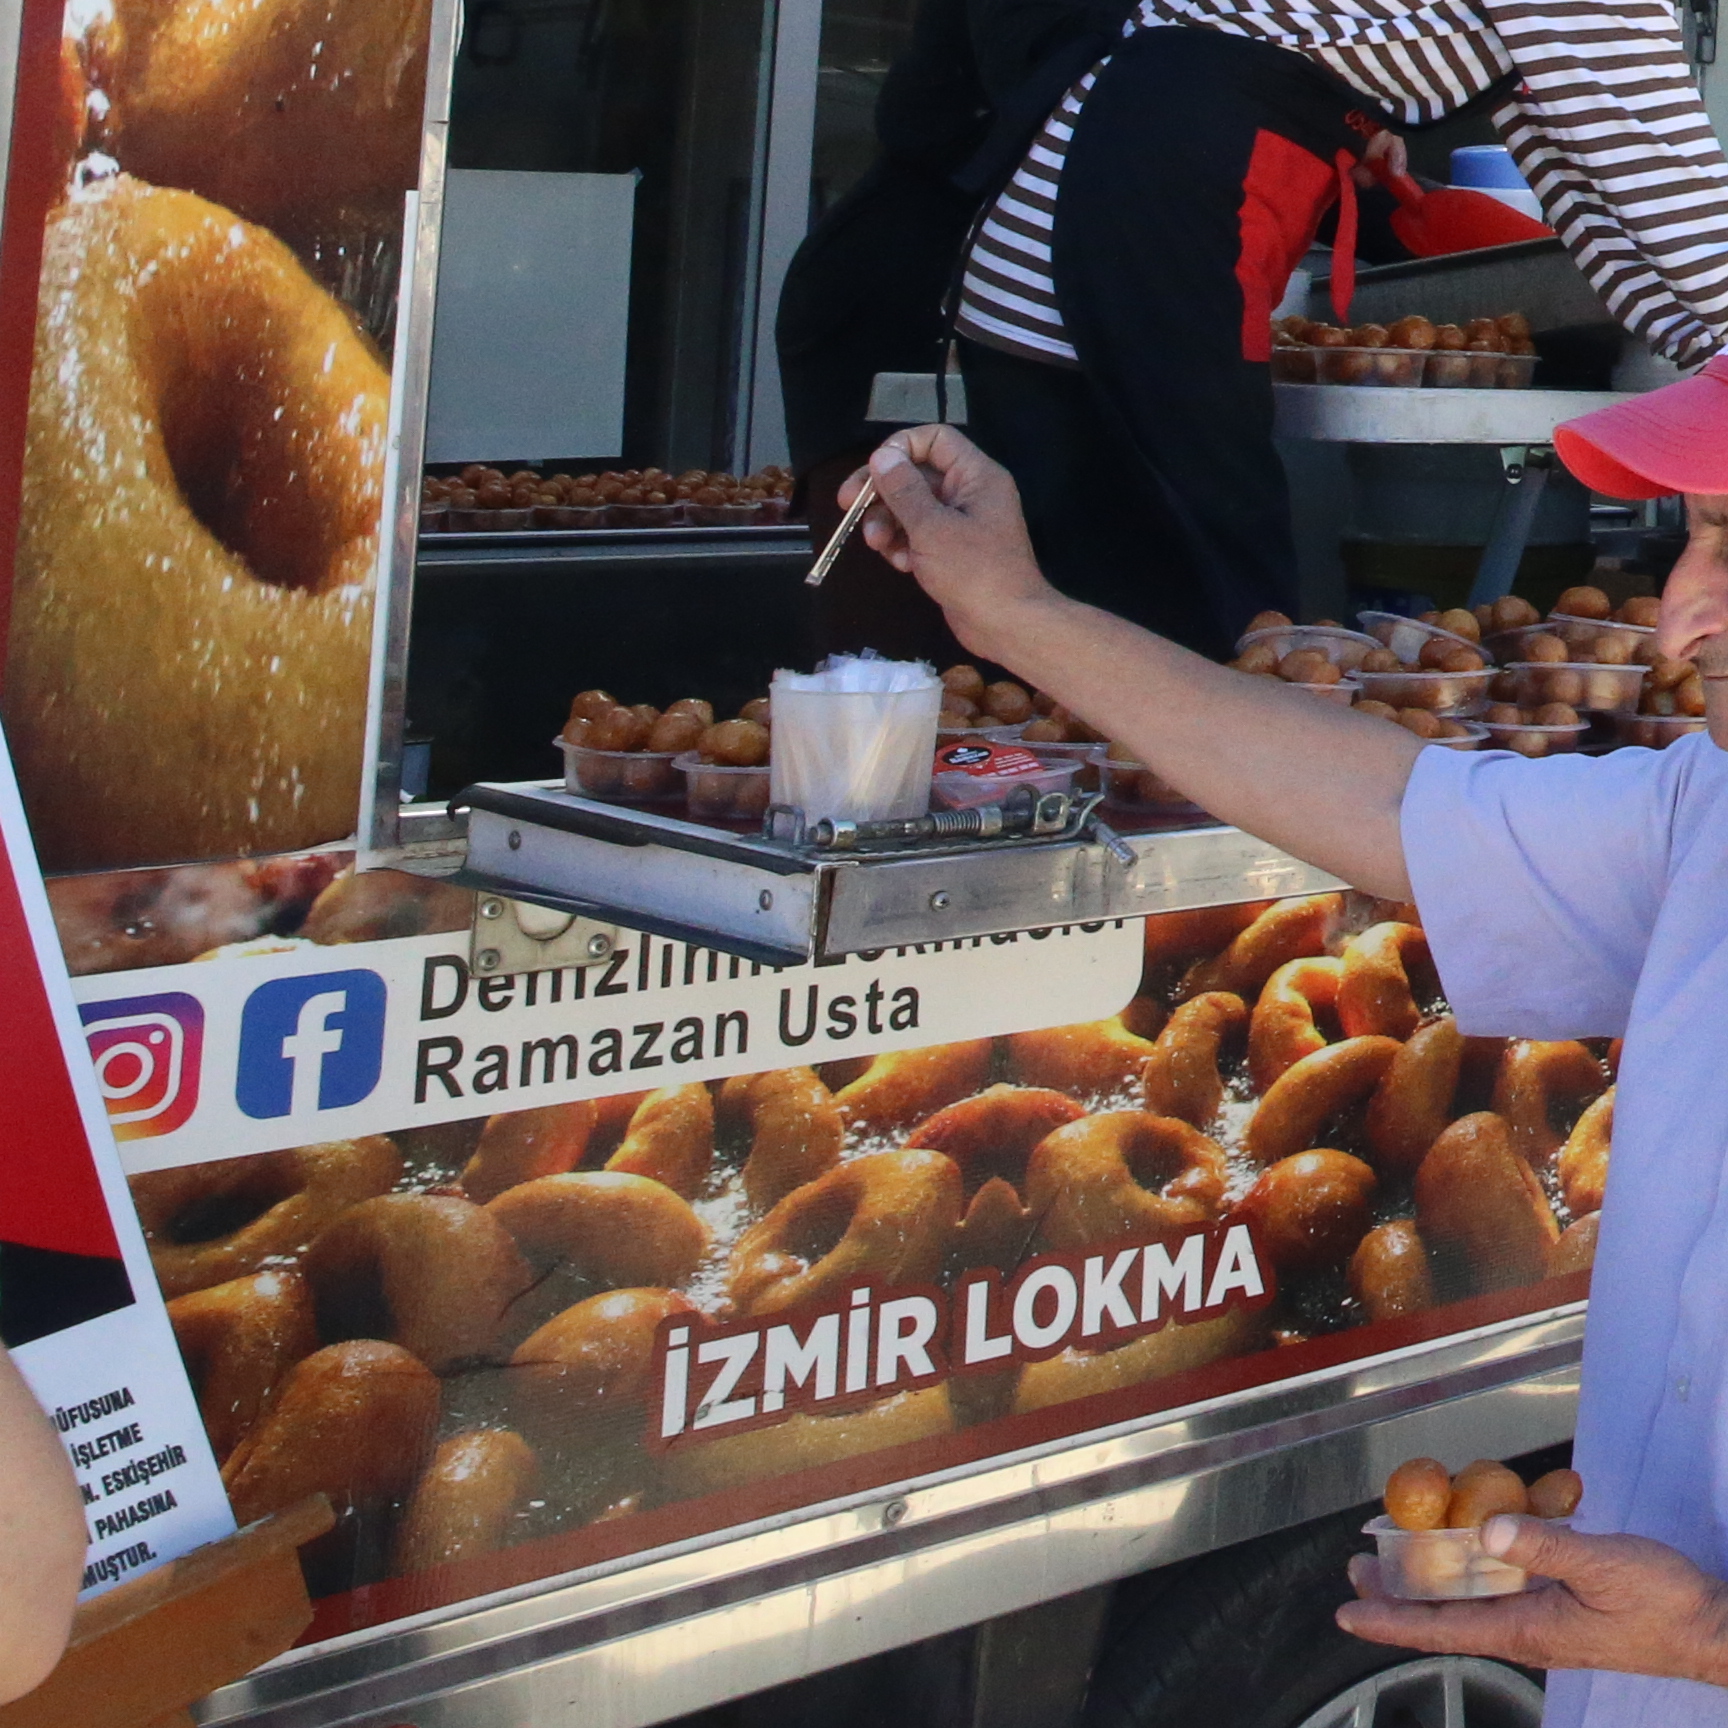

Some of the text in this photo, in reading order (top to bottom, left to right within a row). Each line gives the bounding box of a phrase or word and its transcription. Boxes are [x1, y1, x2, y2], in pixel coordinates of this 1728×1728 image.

[413, 977, 921, 1103] Ramazan Usta
[660, 1222, 1267, 1440] İZMİR LOKMA
[69, 1422, 144, 1470] İŞLETME
[101, 1443, 188, 1498] ESKİŞEHİR
[95, 1489, 178, 1541] PAHASINA
